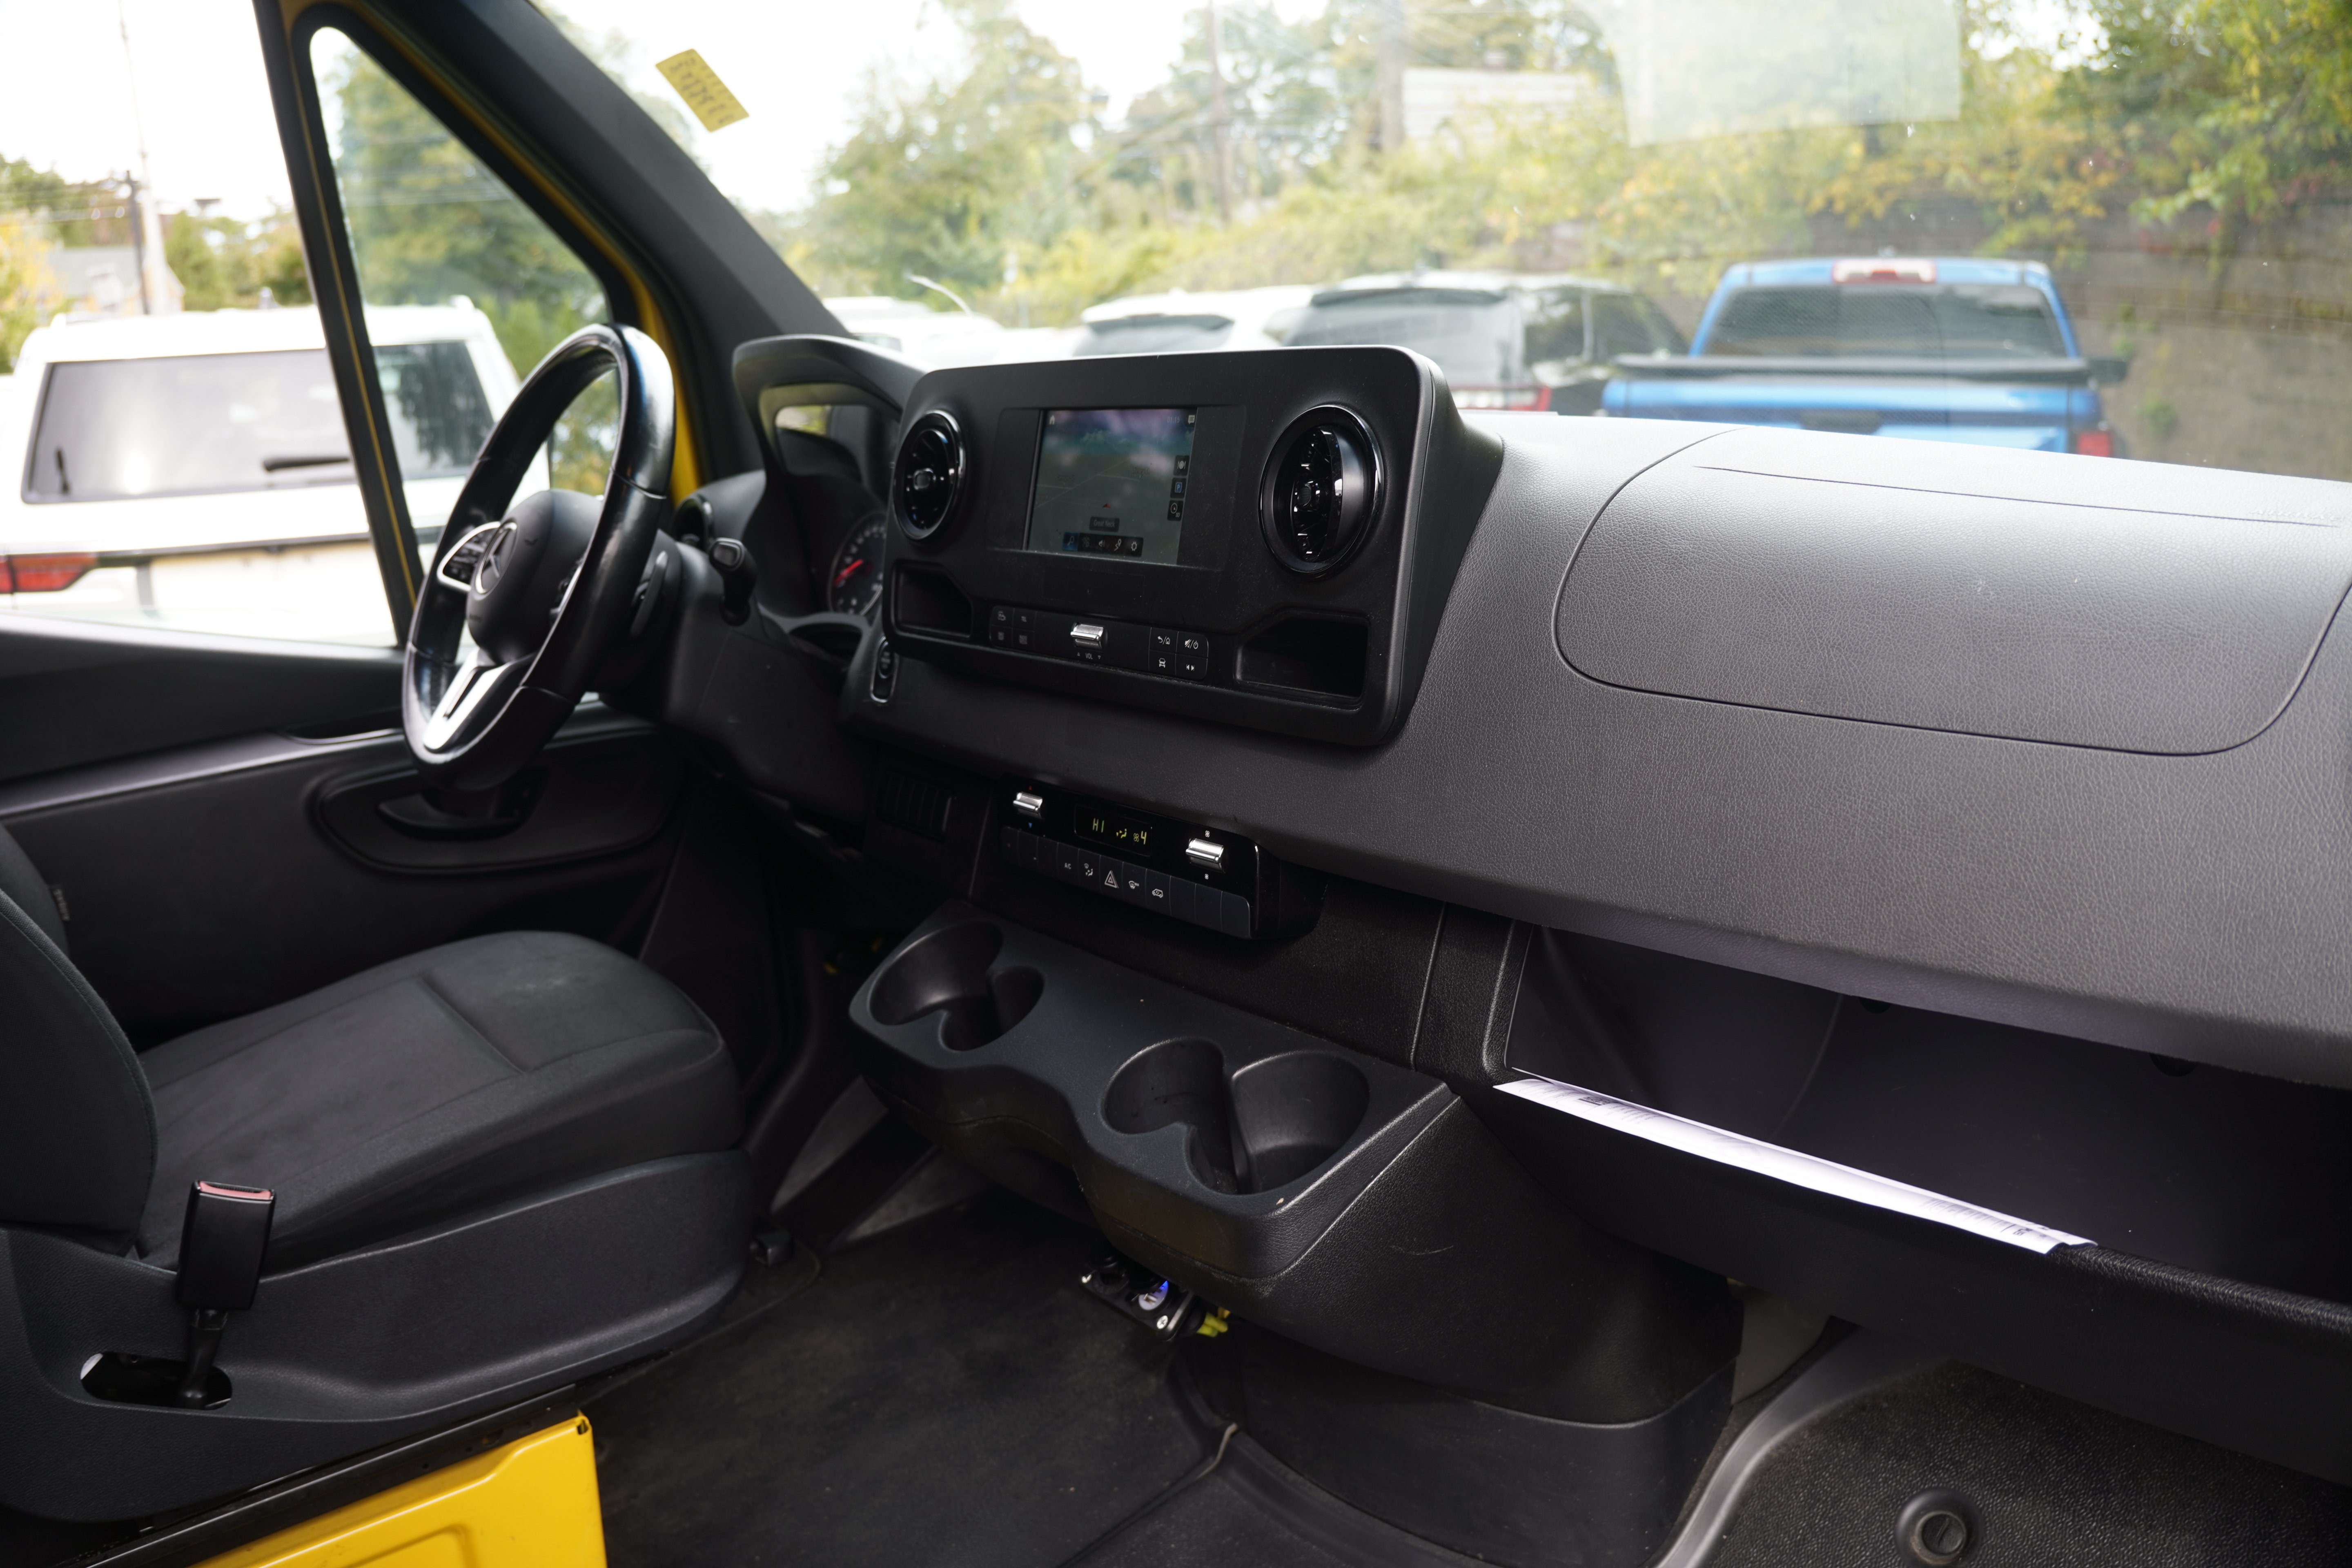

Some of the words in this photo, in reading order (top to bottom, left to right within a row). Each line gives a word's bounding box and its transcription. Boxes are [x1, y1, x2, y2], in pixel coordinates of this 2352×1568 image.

[1094, 519, 1104, 527] Great
[1092, 817, 1105, 833] HI
[1140, 830, 1147, 845] 4
